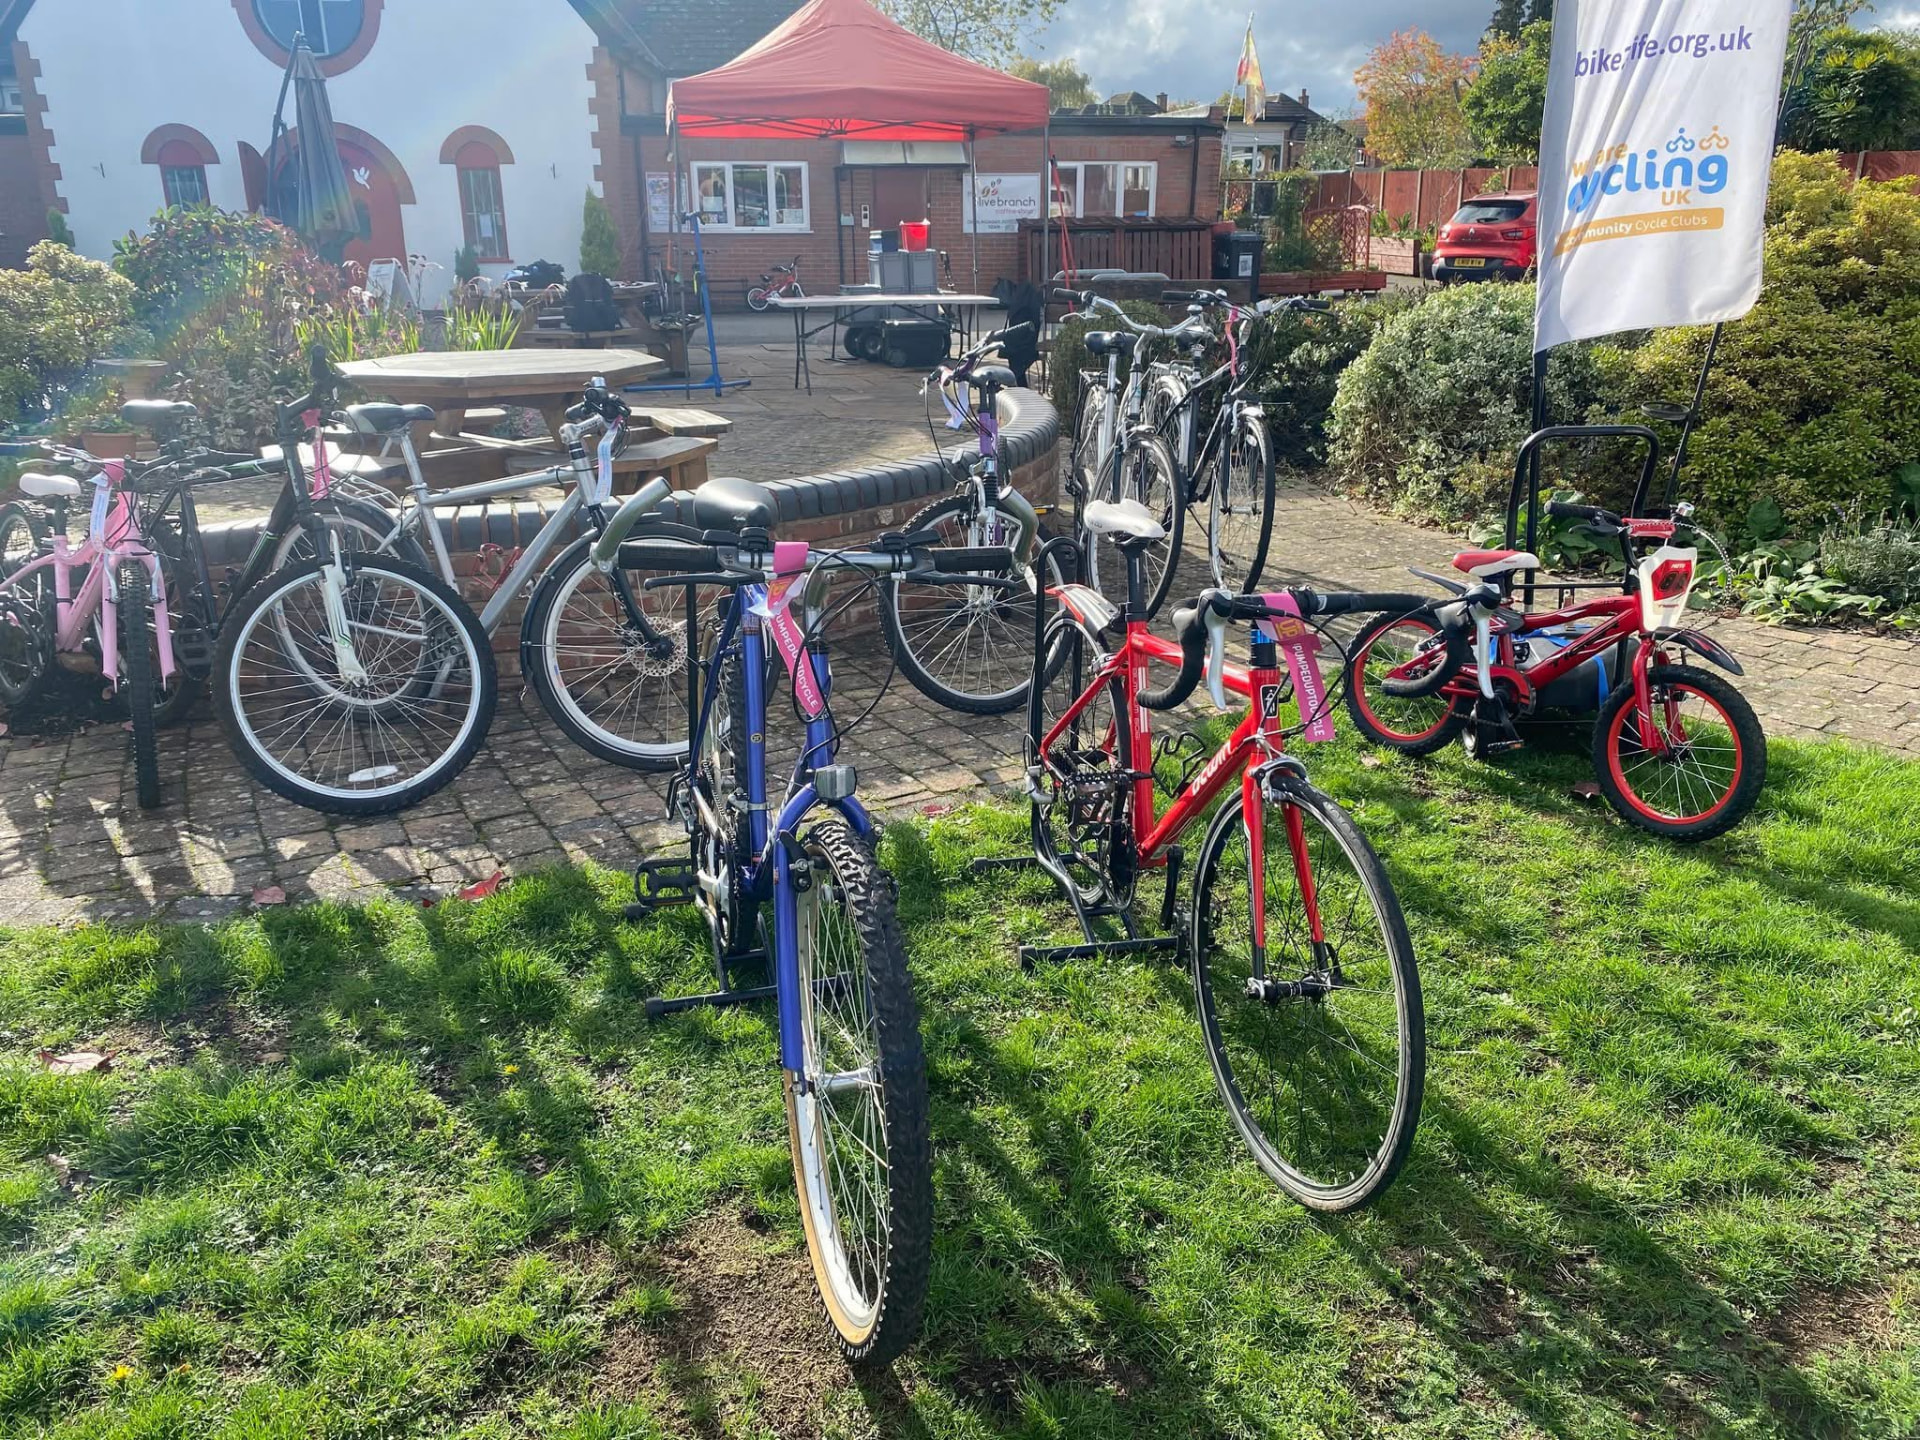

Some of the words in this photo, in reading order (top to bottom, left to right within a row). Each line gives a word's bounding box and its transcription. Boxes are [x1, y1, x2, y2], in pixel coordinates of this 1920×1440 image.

[1662, 189, 1690, 206] UK
[1635, 216, 1668, 231] Cycle
[1671, 215, 1708, 228] Clubs
